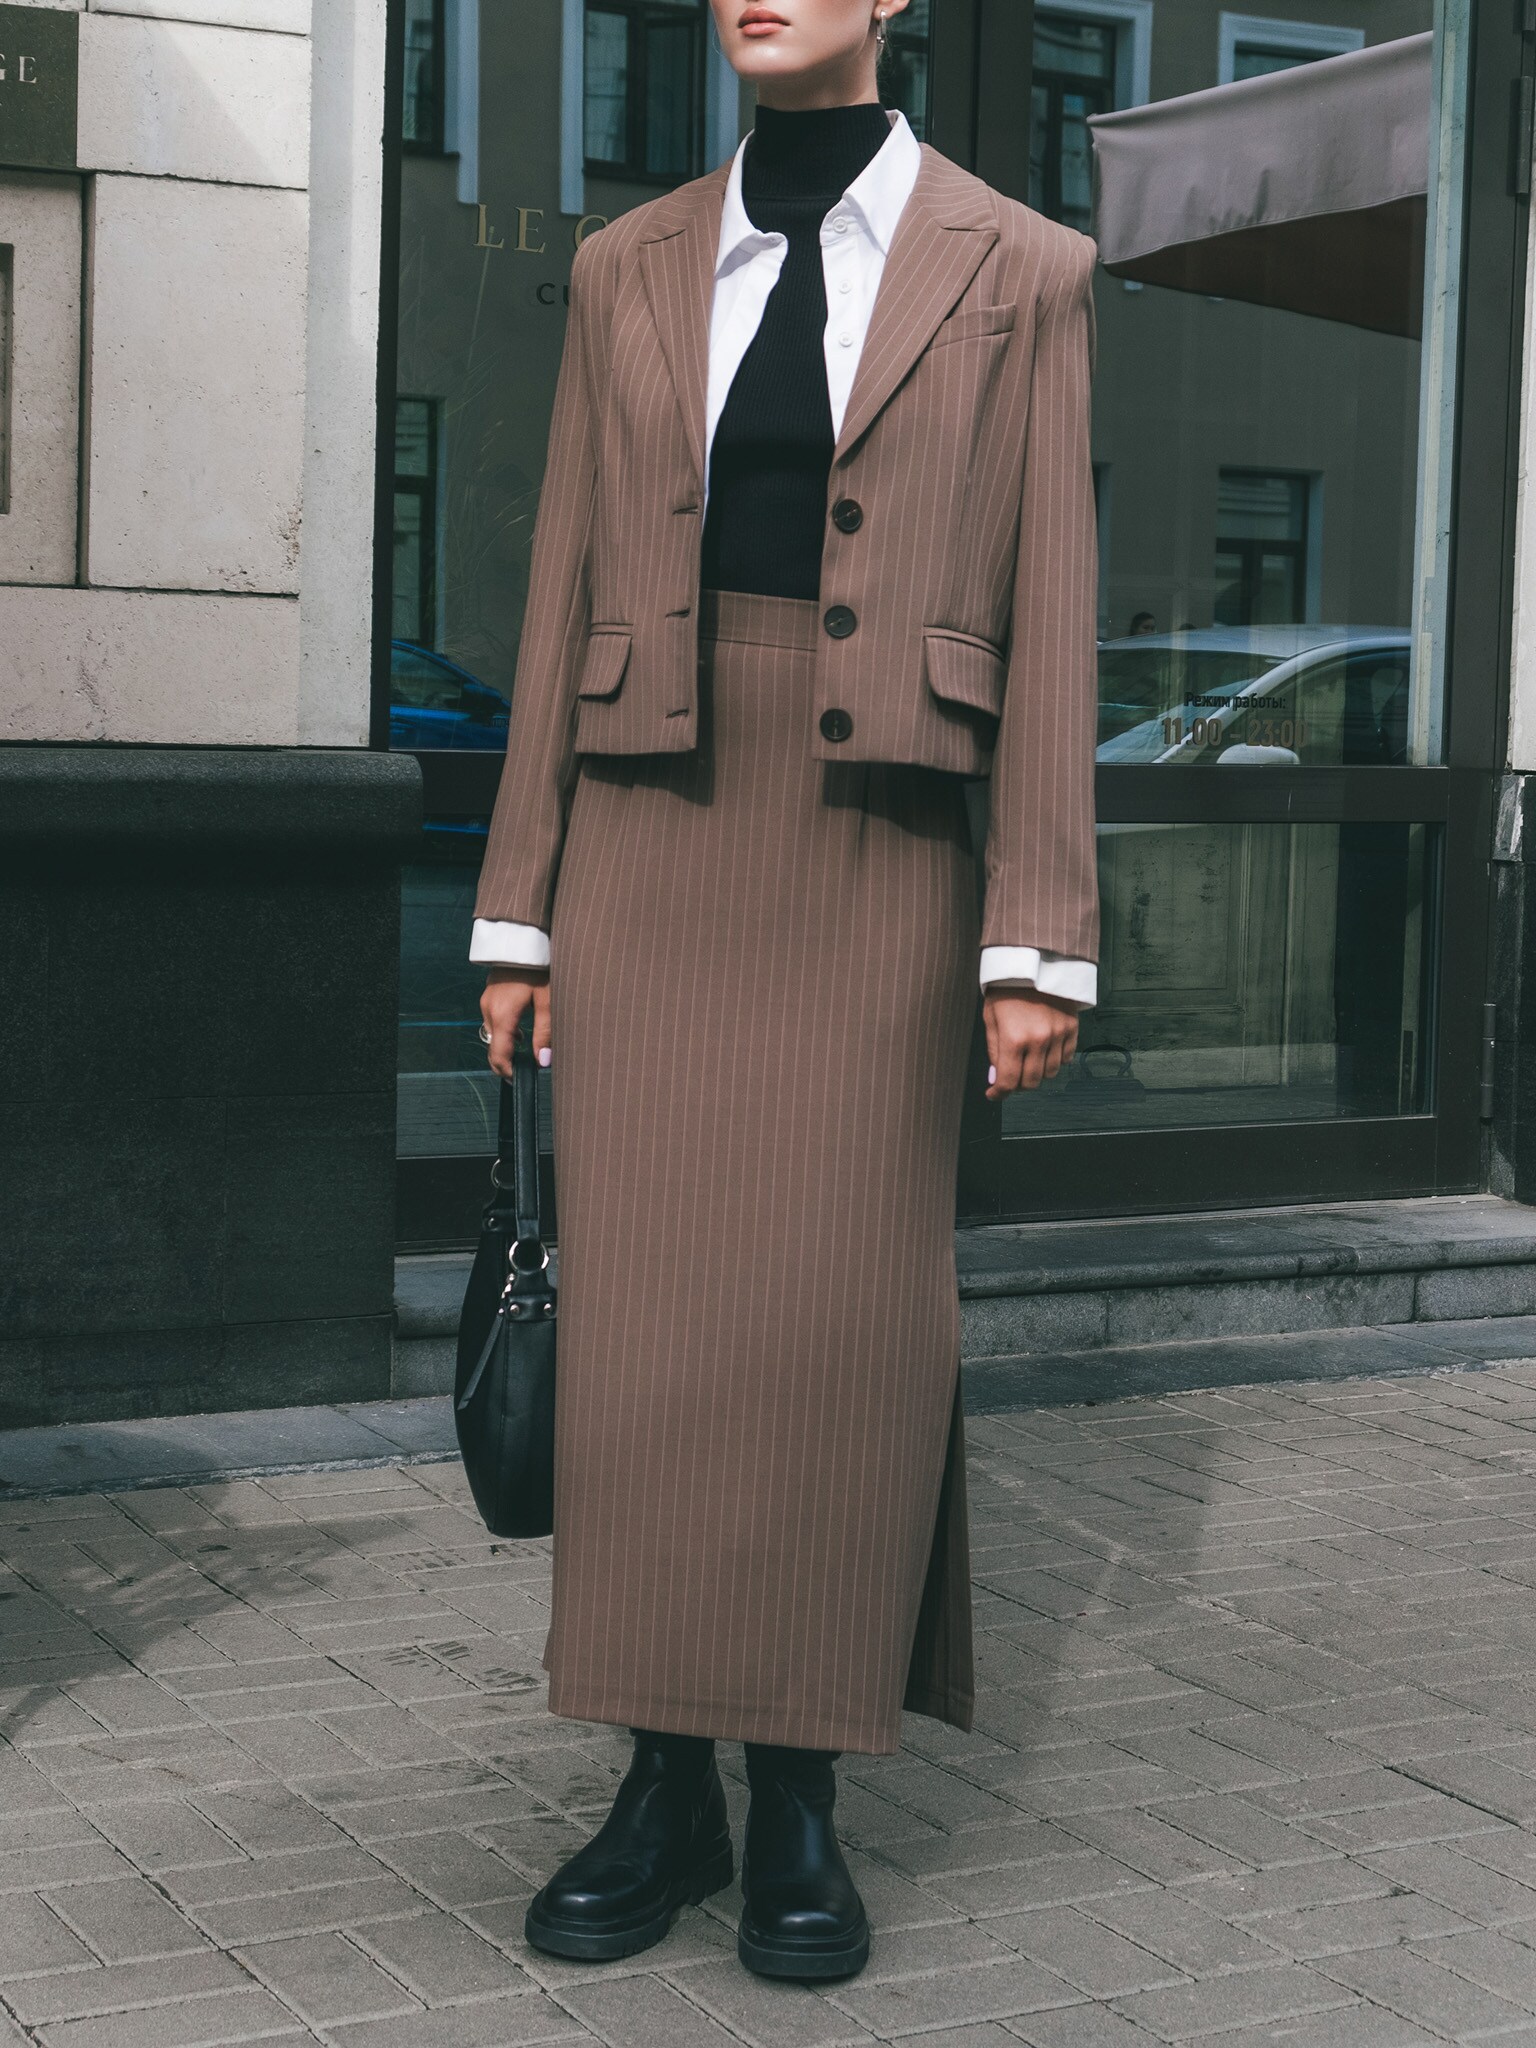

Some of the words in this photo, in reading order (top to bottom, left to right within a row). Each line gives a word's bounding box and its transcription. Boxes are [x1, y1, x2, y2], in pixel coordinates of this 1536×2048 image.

[473, 203, 546, 254] LE
[1183, 691, 1231, 708] Режим
[1232, 692, 1287, 711] работы:
[1162, 716, 1223, 747] 11:00
[1246, 718, 1309, 748] 23:00
